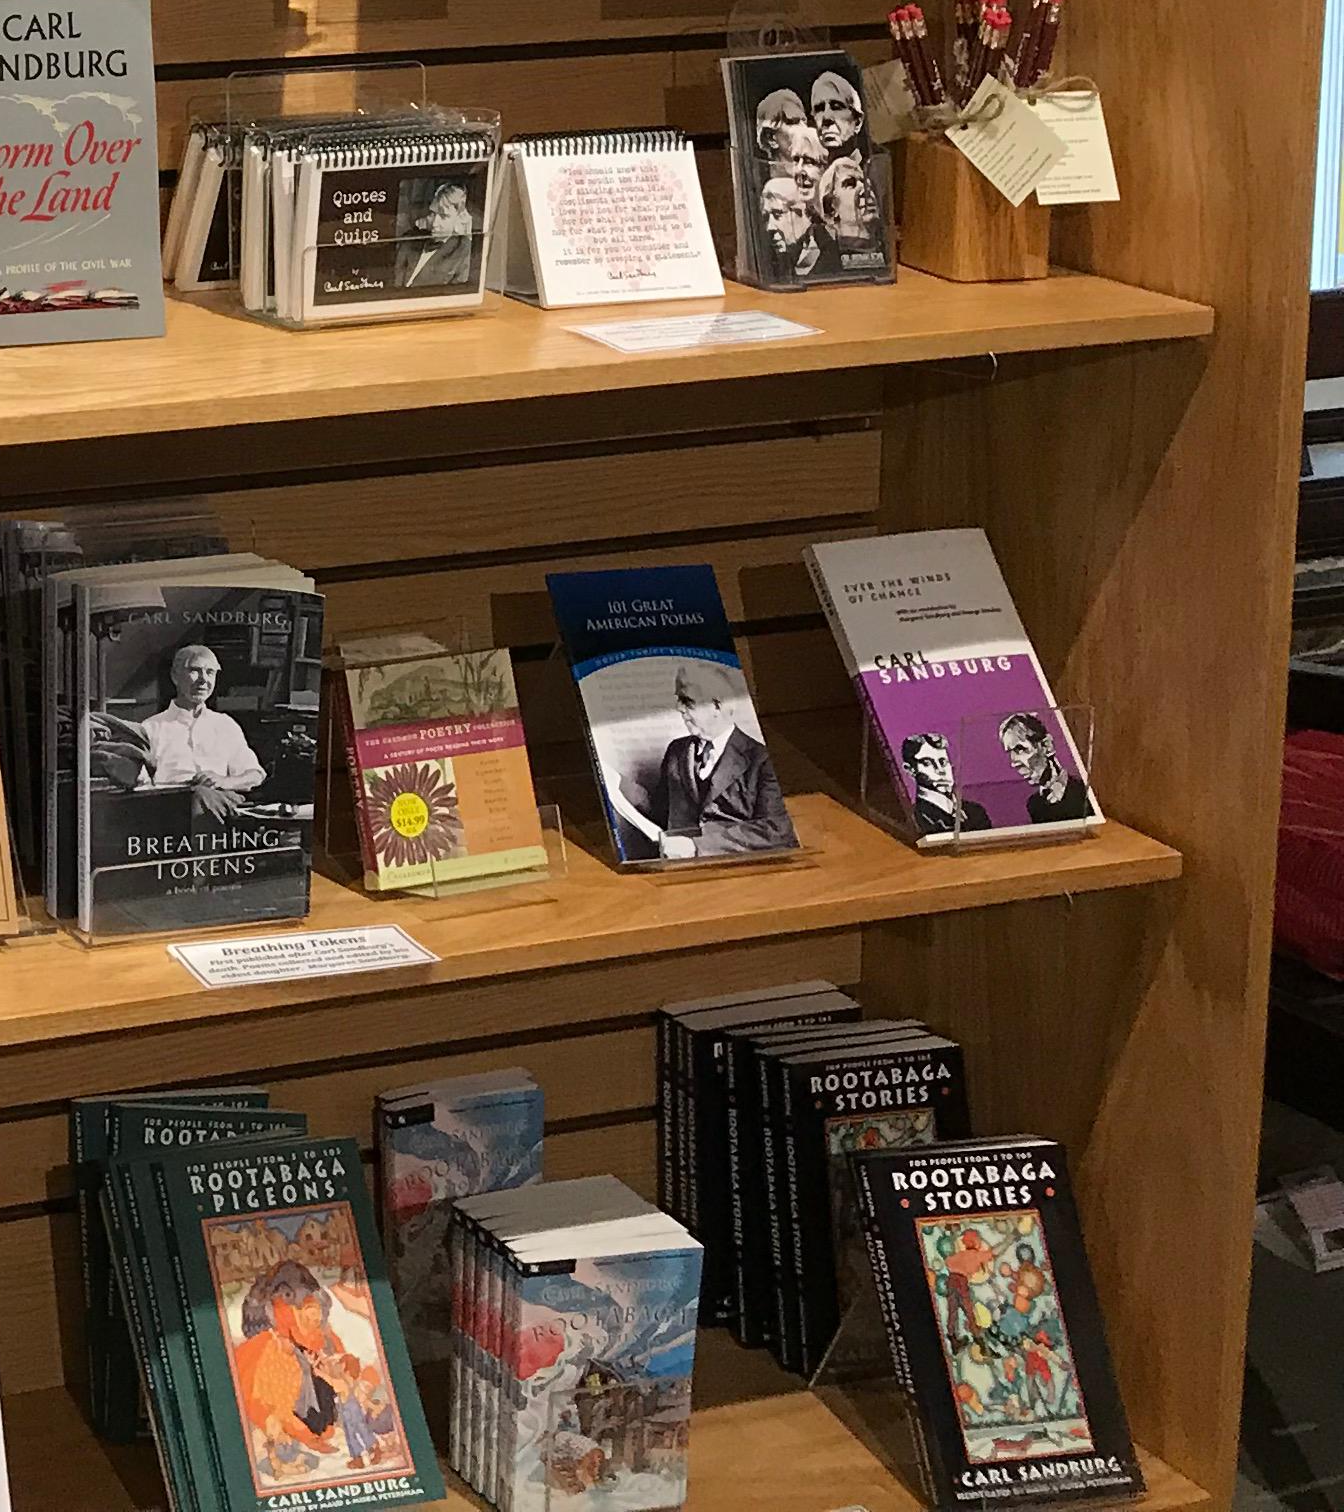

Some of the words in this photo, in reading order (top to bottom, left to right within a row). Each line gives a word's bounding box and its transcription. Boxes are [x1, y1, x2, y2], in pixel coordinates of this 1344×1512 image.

[2, 12, 81, 42] CARL
[63, 120, 141, 166] Over
[21, 172, 120, 223] Land
[332, 189, 388, 207] Quotes
[343, 209, 372, 224] and
[334, 227, 381, 248] Quips
[629, 597, 674, 613] GREAT
[586, 613, 656, 630] AMERICAN
[659, 611, 704, 626] POEMS
[874, 651, 930, 669] CARL
[878, 655, 1012, 685] SANDBURG
[128, 829, 280, 856] BREATHING
[155, 856, 256, 880] TOKENS
[191, 1158, 346, 1194] ROOTABAGA
[893, 1160, 1056, 1192] ROOTABAGA
[212, 1182, 336, 1213] PIGEONS
[925, 1185, 1032, 1211] STORIES
